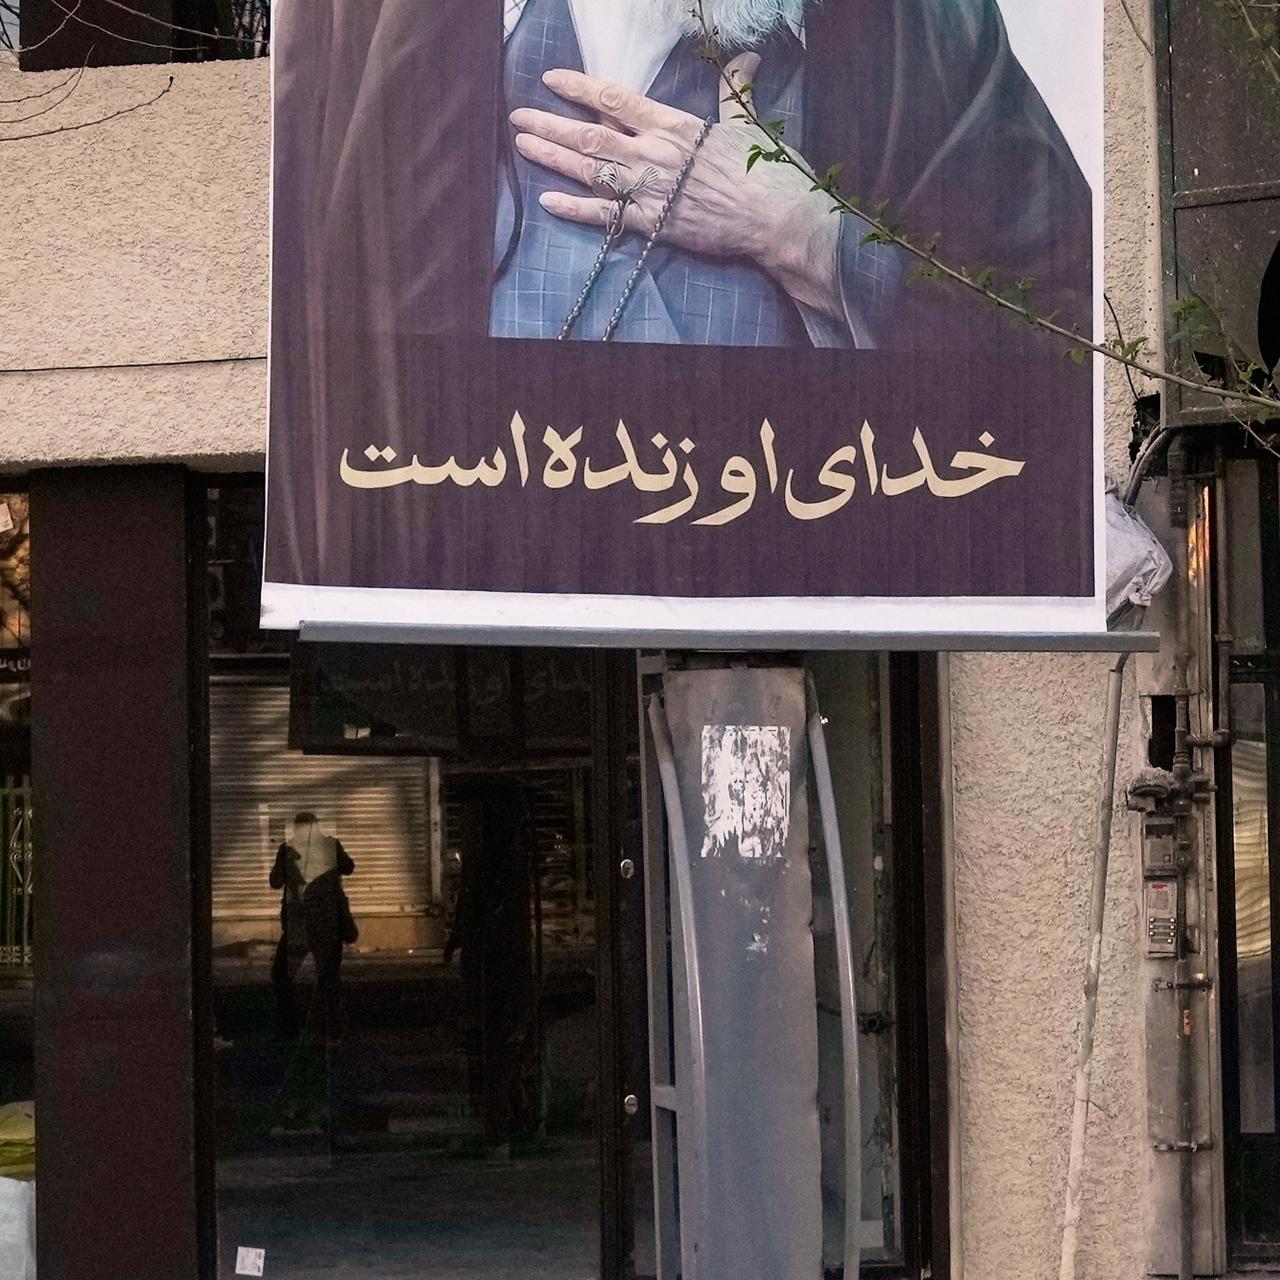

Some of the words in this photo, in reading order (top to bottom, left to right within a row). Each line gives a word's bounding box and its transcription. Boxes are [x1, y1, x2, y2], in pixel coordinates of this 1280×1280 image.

[338, 409, 530, 490] است
[541, 417, 700, 525] زنده
[689, 416, 779, 526] او
[784, 418, 1027, 521] خدای
